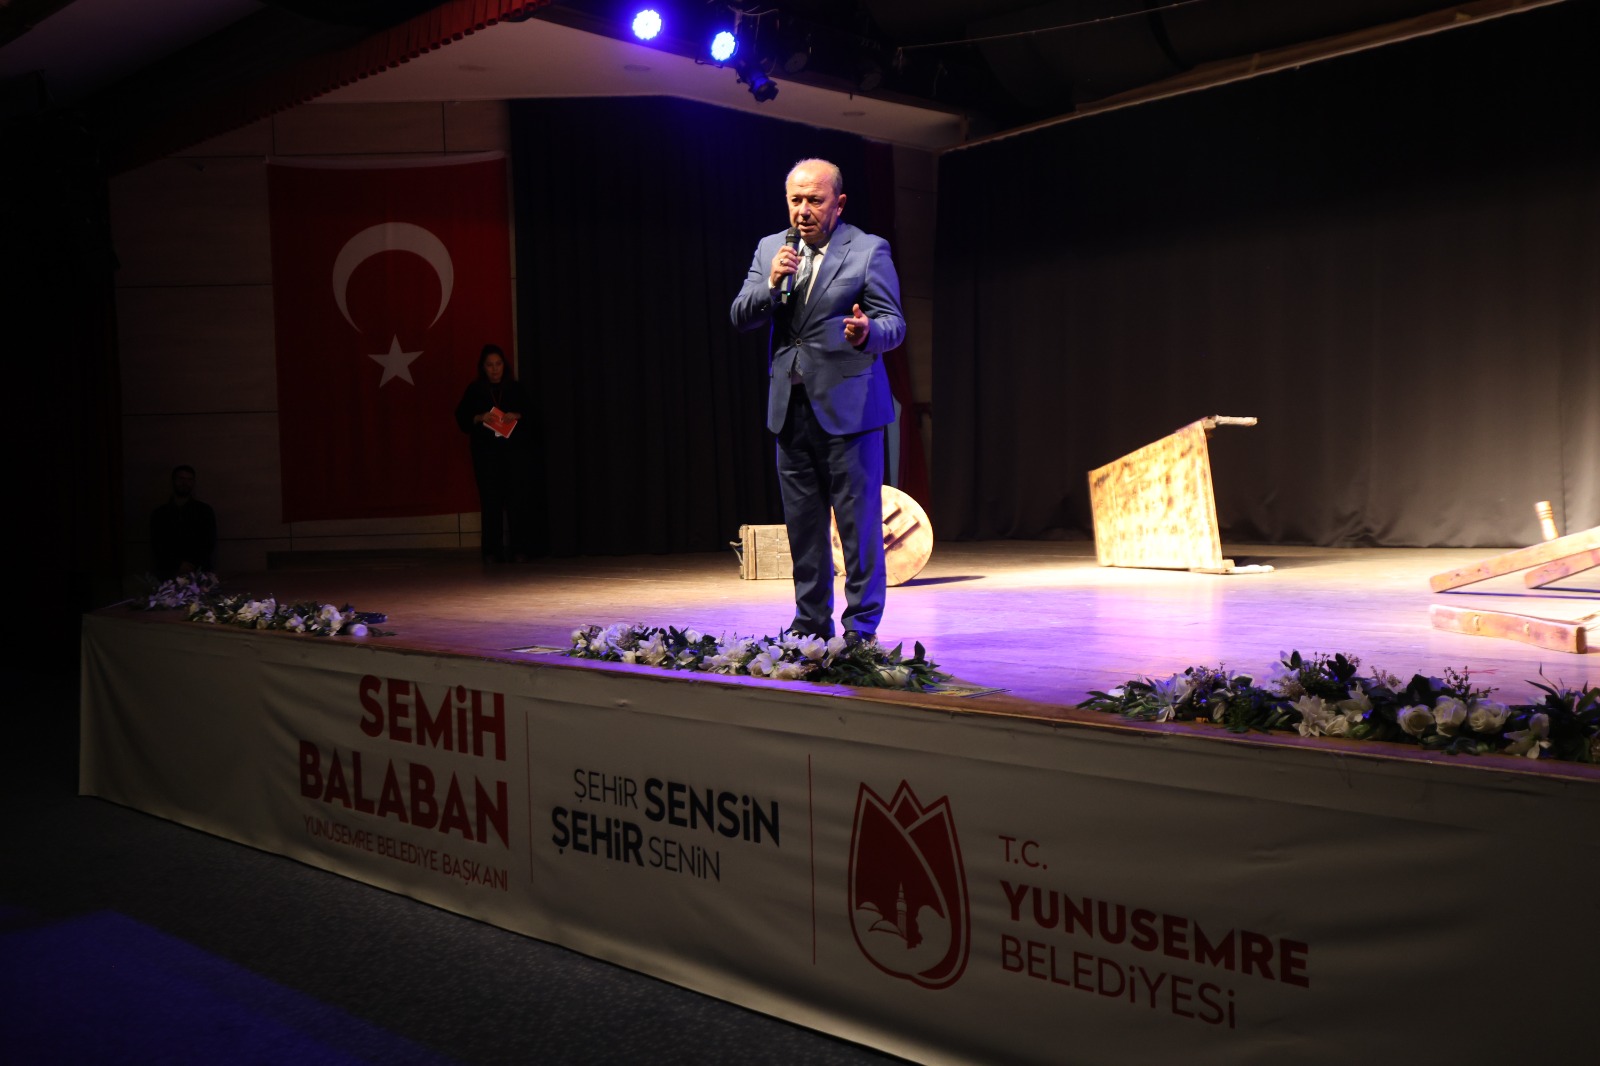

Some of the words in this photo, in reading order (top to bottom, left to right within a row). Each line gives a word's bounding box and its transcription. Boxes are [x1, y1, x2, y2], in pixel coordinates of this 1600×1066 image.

[300, 739, 509, 850] BALABAN
[304, 814, 374, 852] YUNUSEMRE
[443, 853, 508, 892] BAŞKANI
[999, 835, 1048, 870] T.C.
[1001, 880, 1310, 988] YUNUSEMRE
